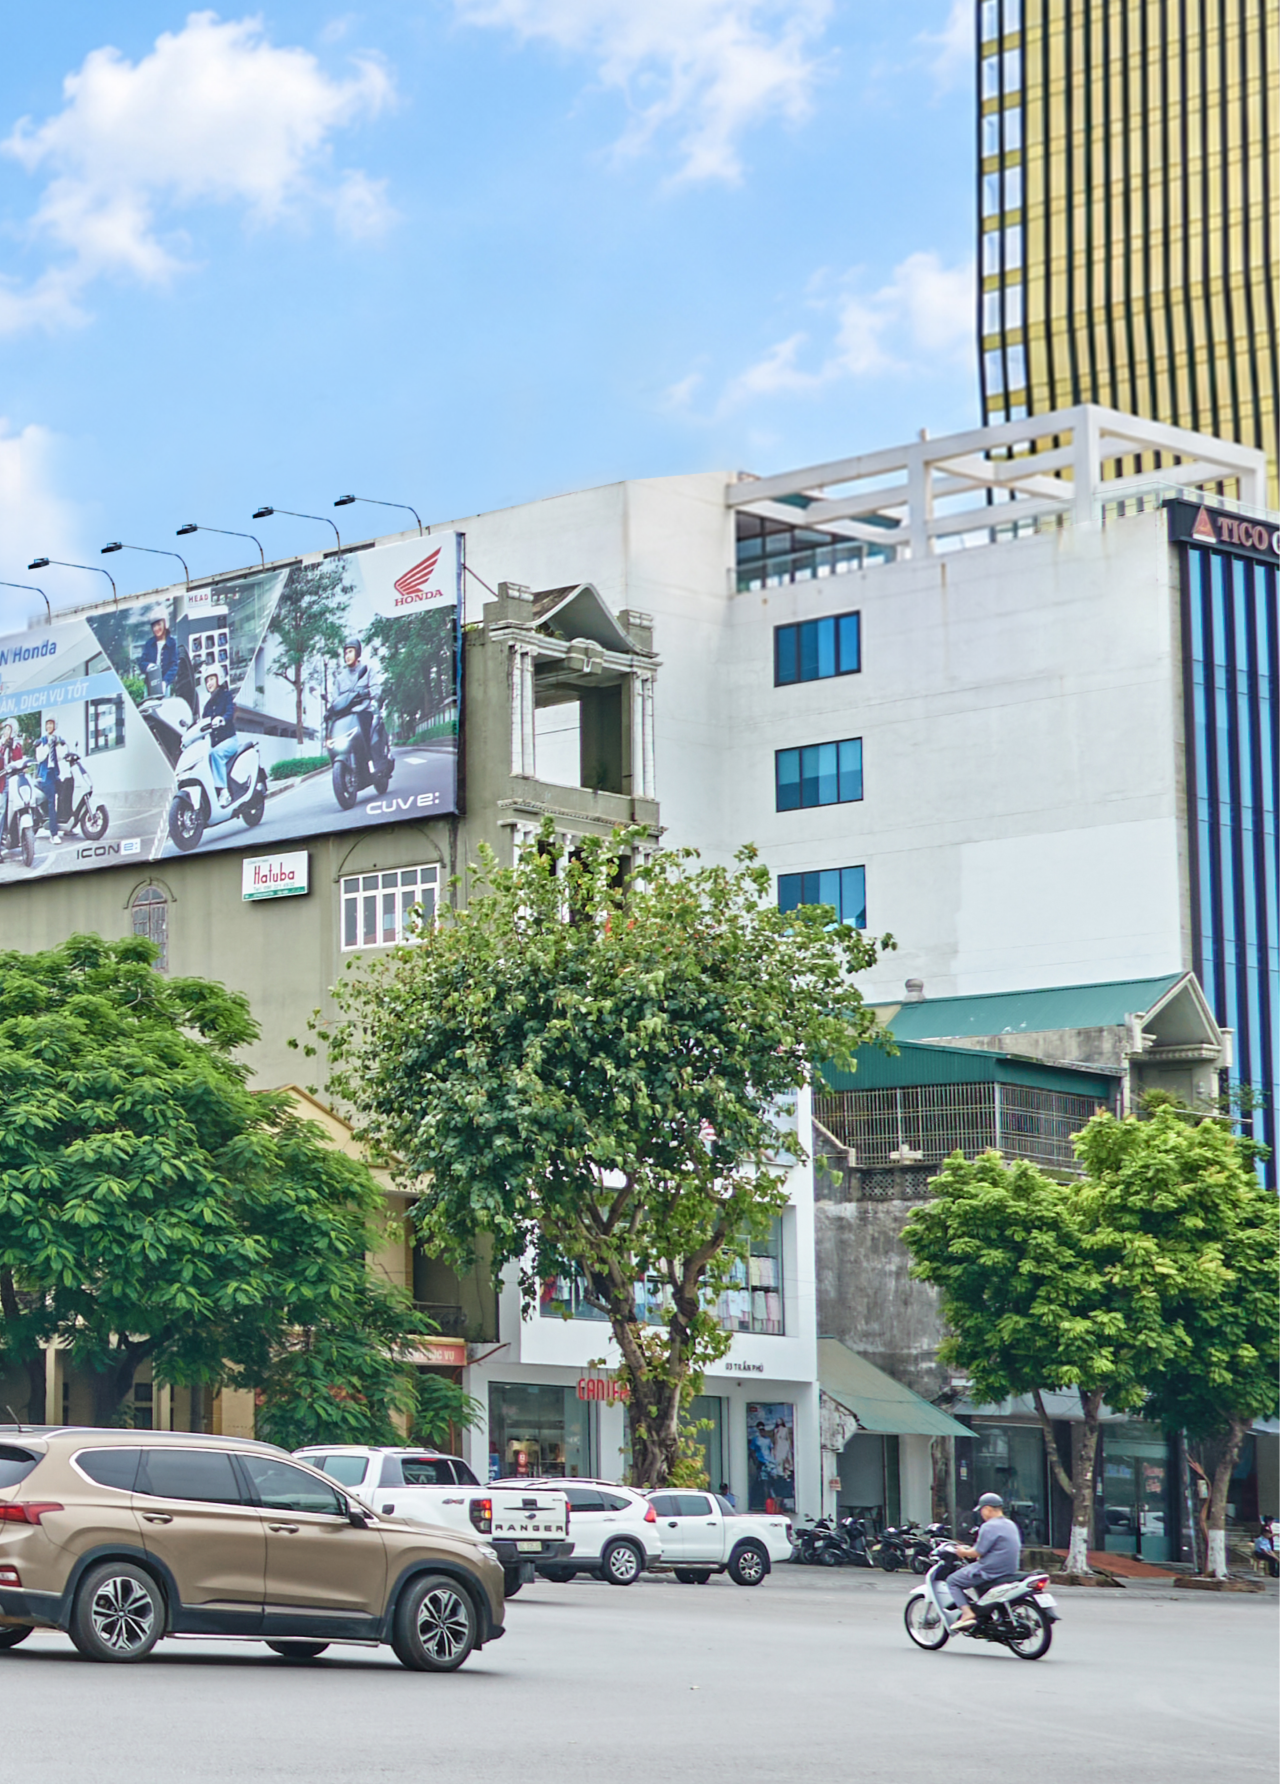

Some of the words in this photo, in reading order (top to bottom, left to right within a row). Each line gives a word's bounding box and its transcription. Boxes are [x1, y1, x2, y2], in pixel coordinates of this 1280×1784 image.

[1217, 517, 1268, 550] TICO
[188, 593, 209, 603] HEAD
[394, 589, 443, 607] HONDA
[12, 640, 57, 663] Honda
[21, 692, 47, 711] DỊCH
[49, 688, 64, 702] VỤ
[67, 681, 89, 697] TỐT
[76, 843, 120, 859] ICON
[253, 862, 295, 885] Hatuba
[444, 1350, 455, 1362] VỤ
[495, 1523, 564, 1533] RANGER
